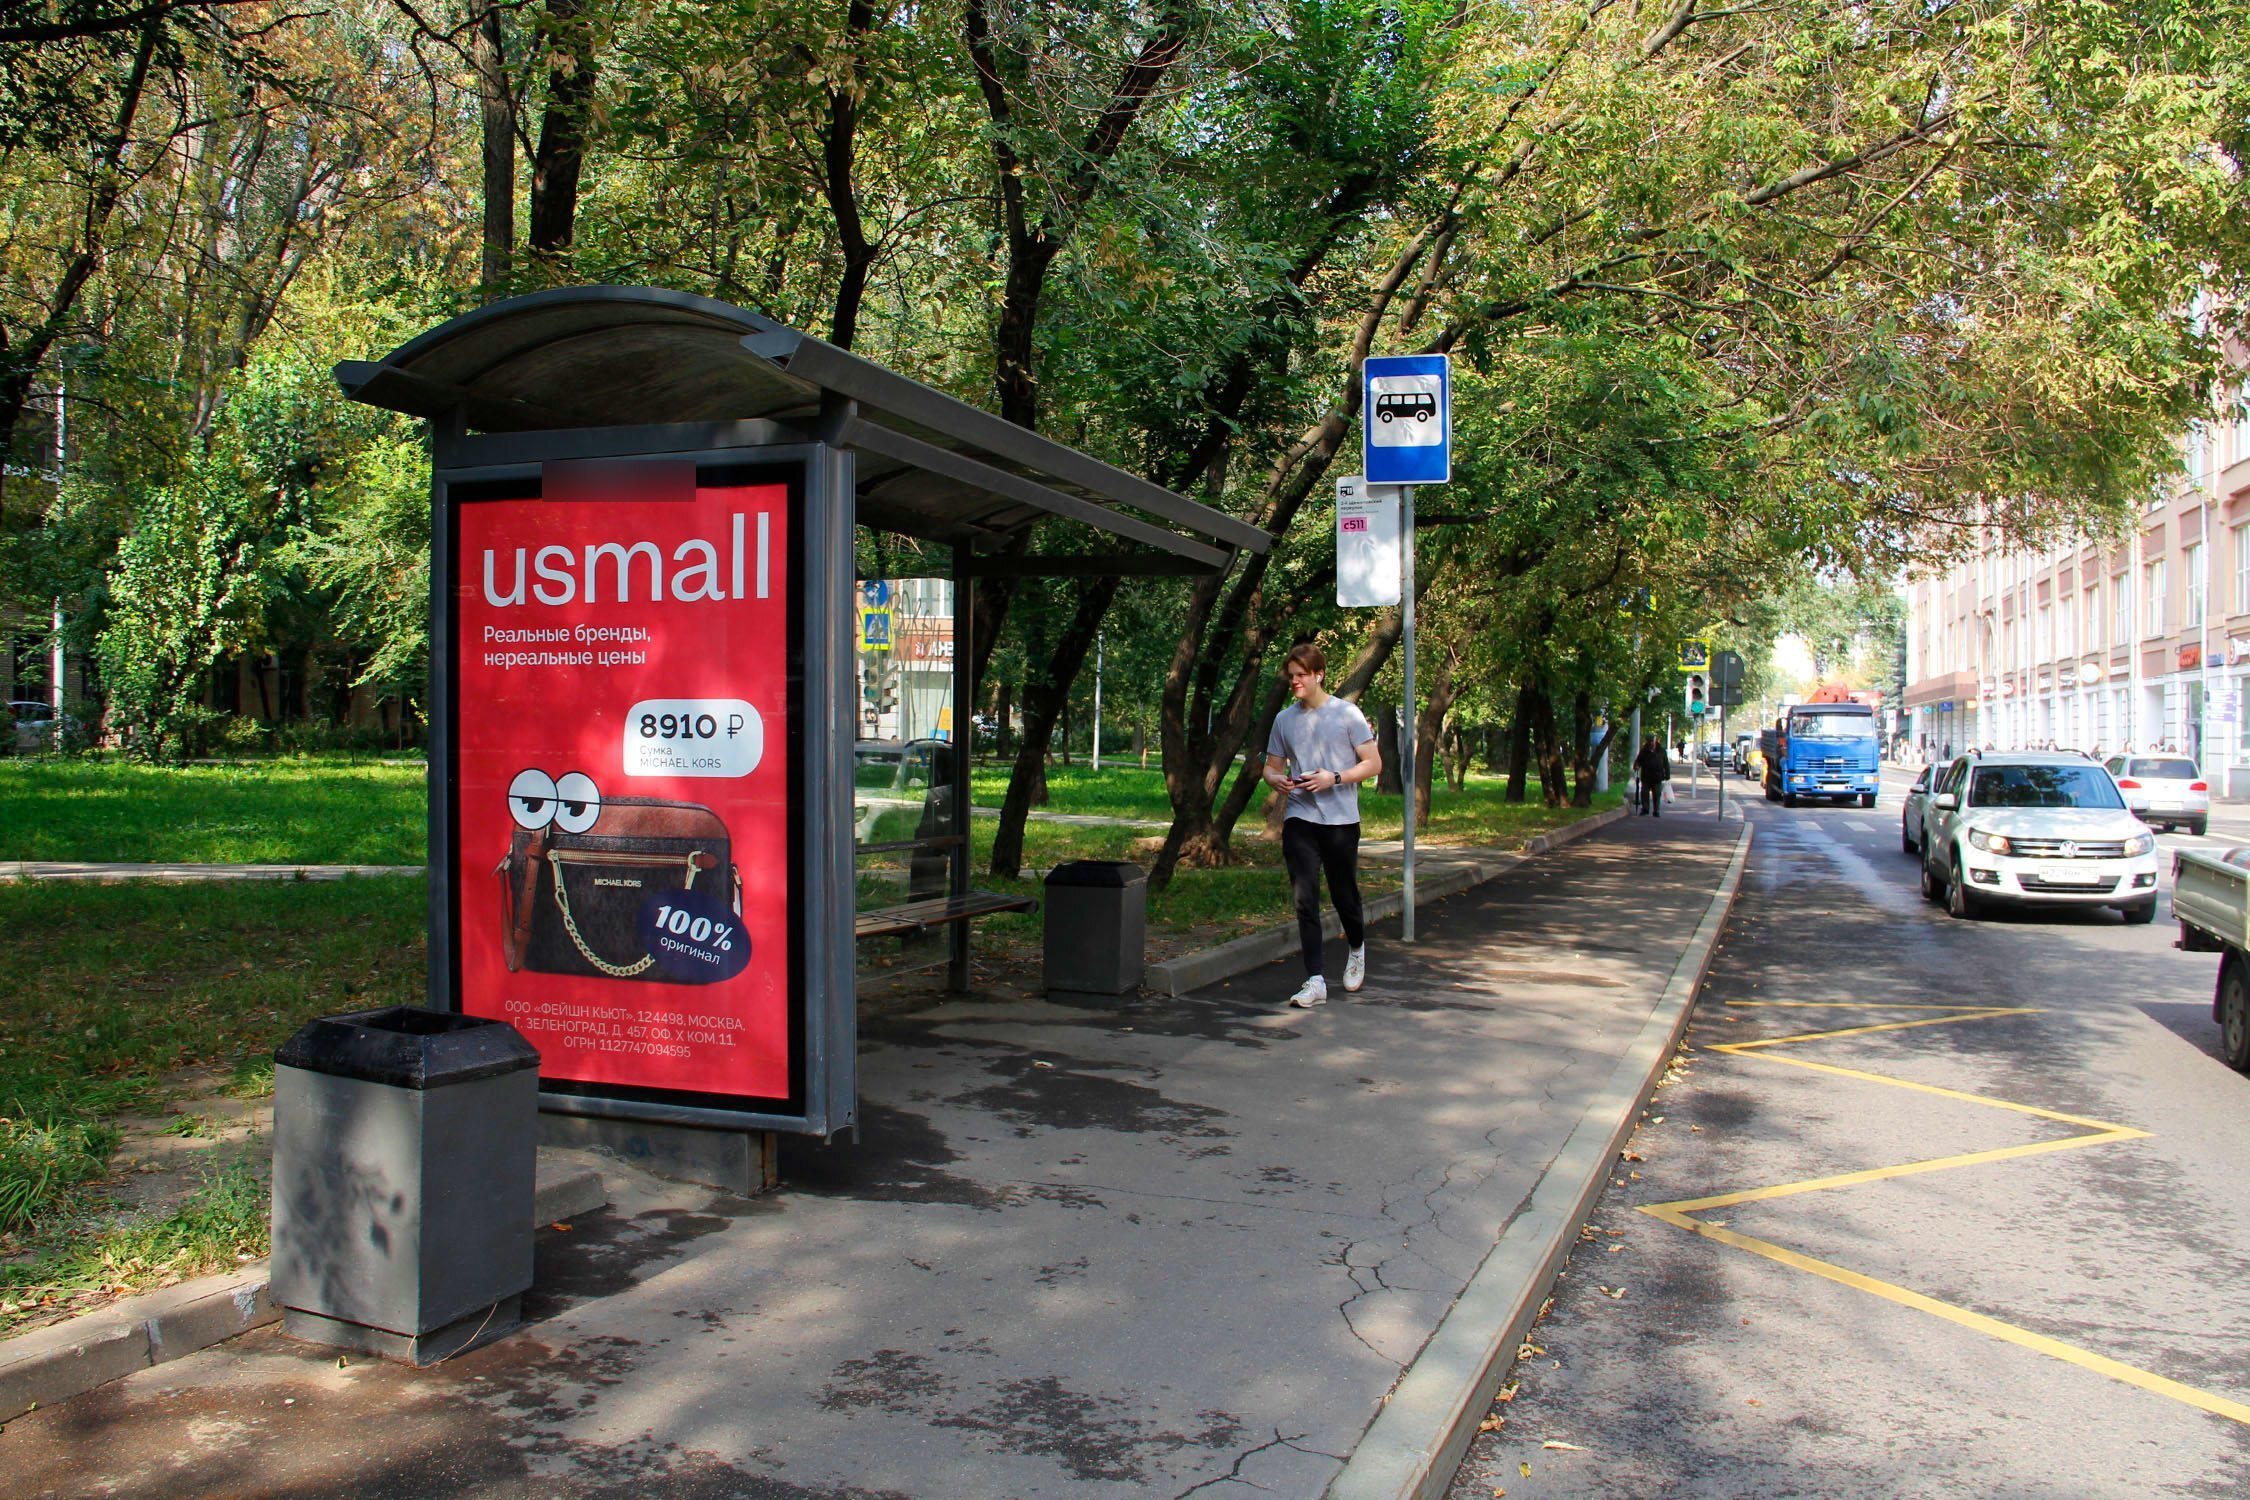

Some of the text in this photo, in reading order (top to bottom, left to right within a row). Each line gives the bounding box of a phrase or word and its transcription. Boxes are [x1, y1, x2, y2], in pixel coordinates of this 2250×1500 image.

[484, 511, 770, 608] usmall
[484, 623, 652, 646] Реальные бренды,
[484, 650, 646, 670] нереальные цены
[640, 713, 718, 739] 8910
[640, 745, 673, 756] Сумка
[640, 758, 722, 769] MICHAEL KORS
[594, 878, 642, 888] MICHAEL KORS
[656, 905, 733, 951] 100%
[660, 937, 721, 965] оригинал
[505, 1000, 530, 1013] ООО
[534, 1002, 589, 1017] «ФЕЙШН
[688, 1014, 746, 1032] МОСКВА,
[514, 1017, 523, 1028] Г.
[526, 1018, 609, 1037] ЗЕЛЕНОГРАД,
[563, 1036, 692, 1058] ОГРН 1127747094595
